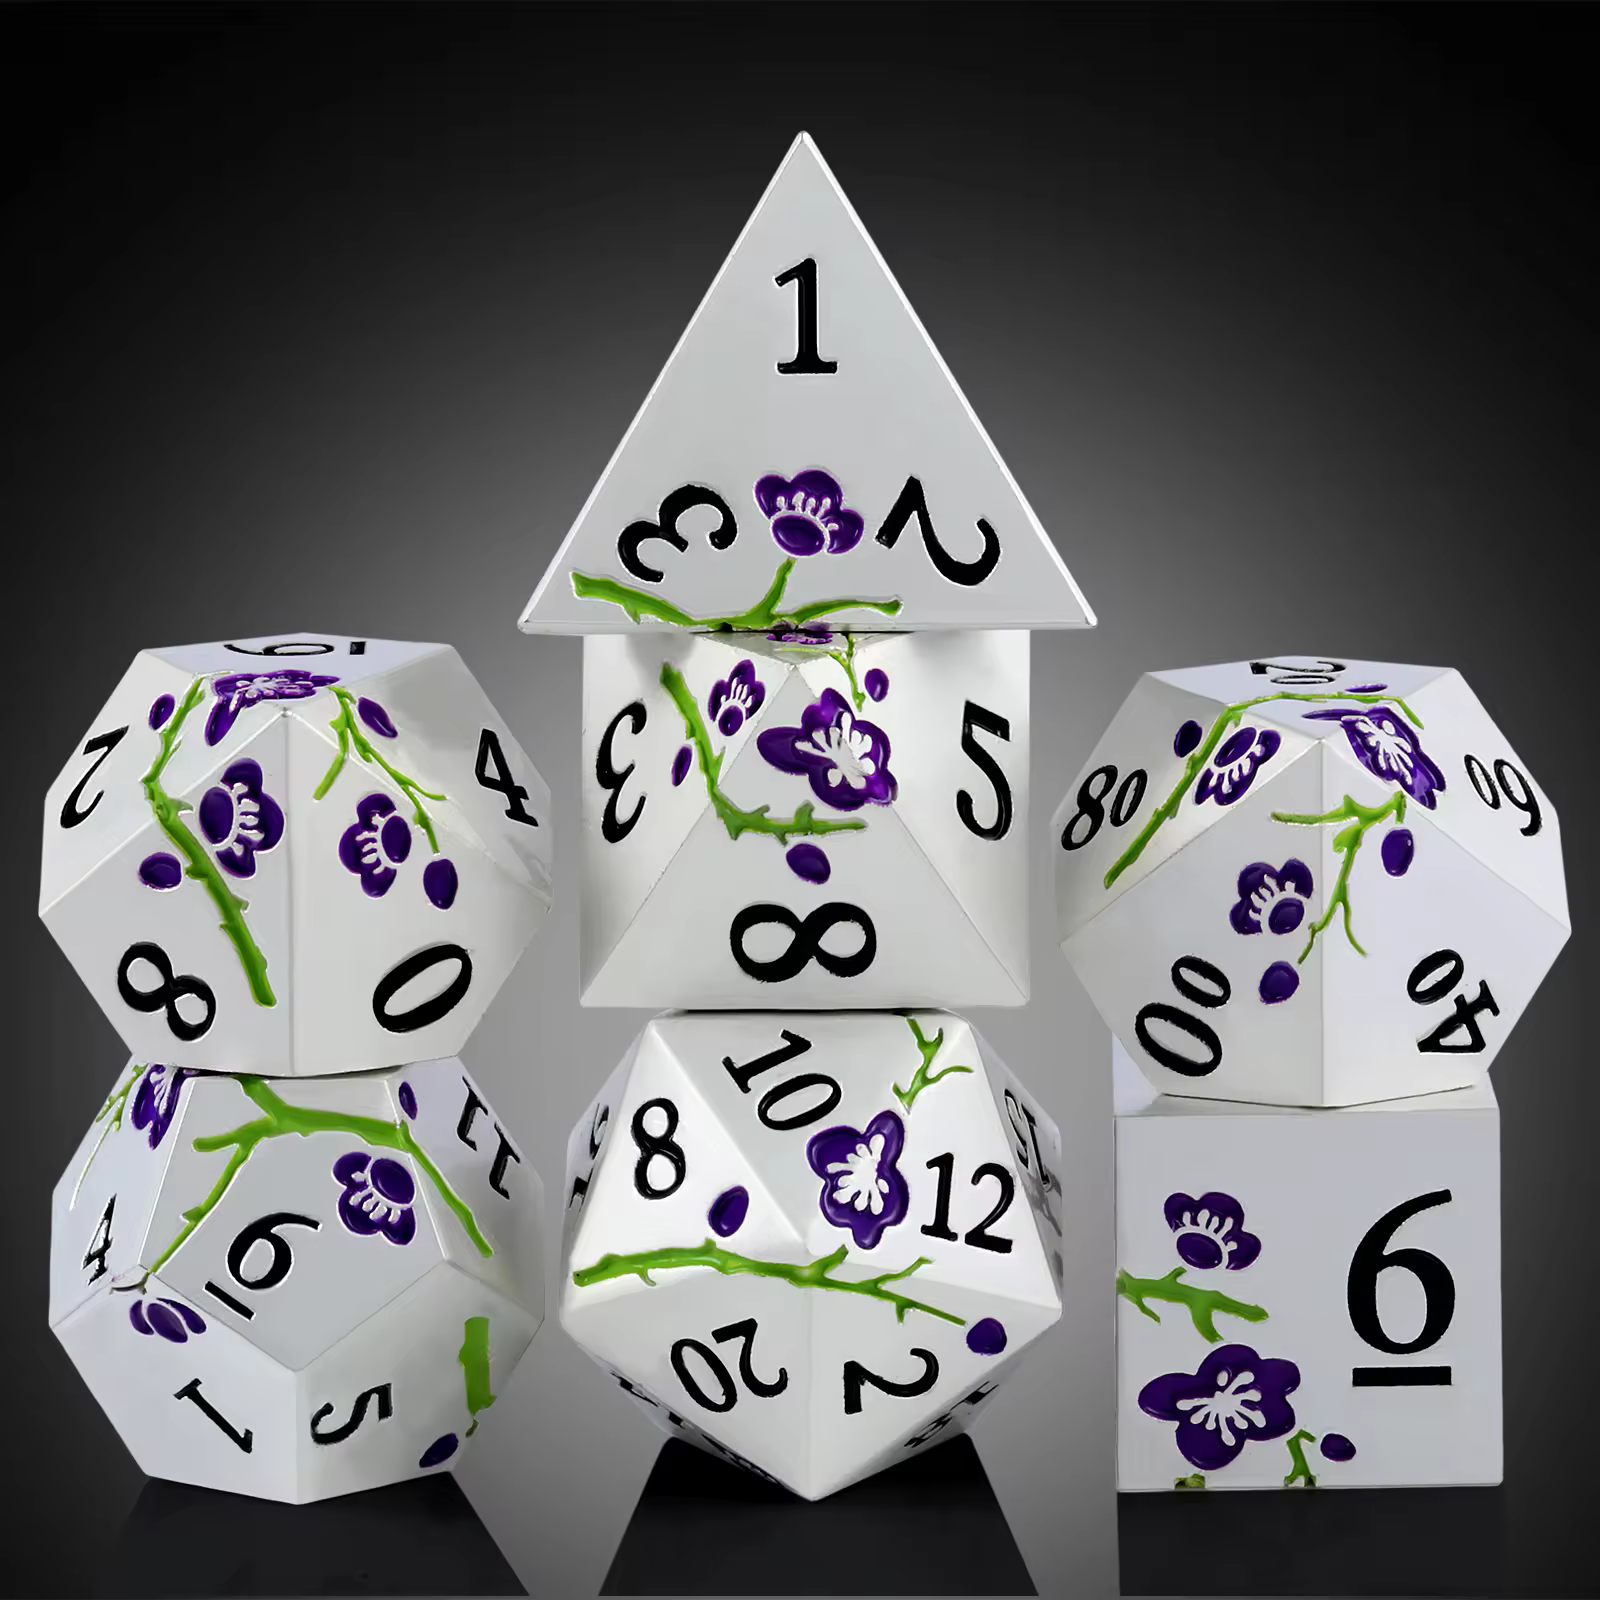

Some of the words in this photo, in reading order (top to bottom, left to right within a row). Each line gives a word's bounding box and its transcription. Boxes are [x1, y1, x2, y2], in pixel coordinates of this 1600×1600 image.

[775, 258, 837, 374] 1
[618, 484, 737, 582] 3
[876, 476, 1000, 586] 2
[61, 726, 128, 829] 2
[475, 729, 538, 827] 4
[596, 702, 646, 843] 3
[957, 701, 1012, 840] 5
[1061, 765, 1147, 851] 80
[118, 942, 216, 1041] 8
[373, 944, 472, 1033] 0
[730, 902, 876, 983] 8
[1135, 956, 1231, 1077] 00
[1407, 950, 1499, 1053] 40
[723, 1030, 841, 1130] 10
[631, 1098, 686, 1199] 8
[83, 1193, 117, 1285] 4
[921, 1153, 1014, 1253] 12
[205, 1213, 319, 1320] 6
[1348, 1189, 1455, 1387] 6
[311, 1383, 392, 1445] 5
[671, 1318, 788, 1412] 20
[843, 1348, 939, 1414] 2
[174, 1378, 252, 1453] 1
